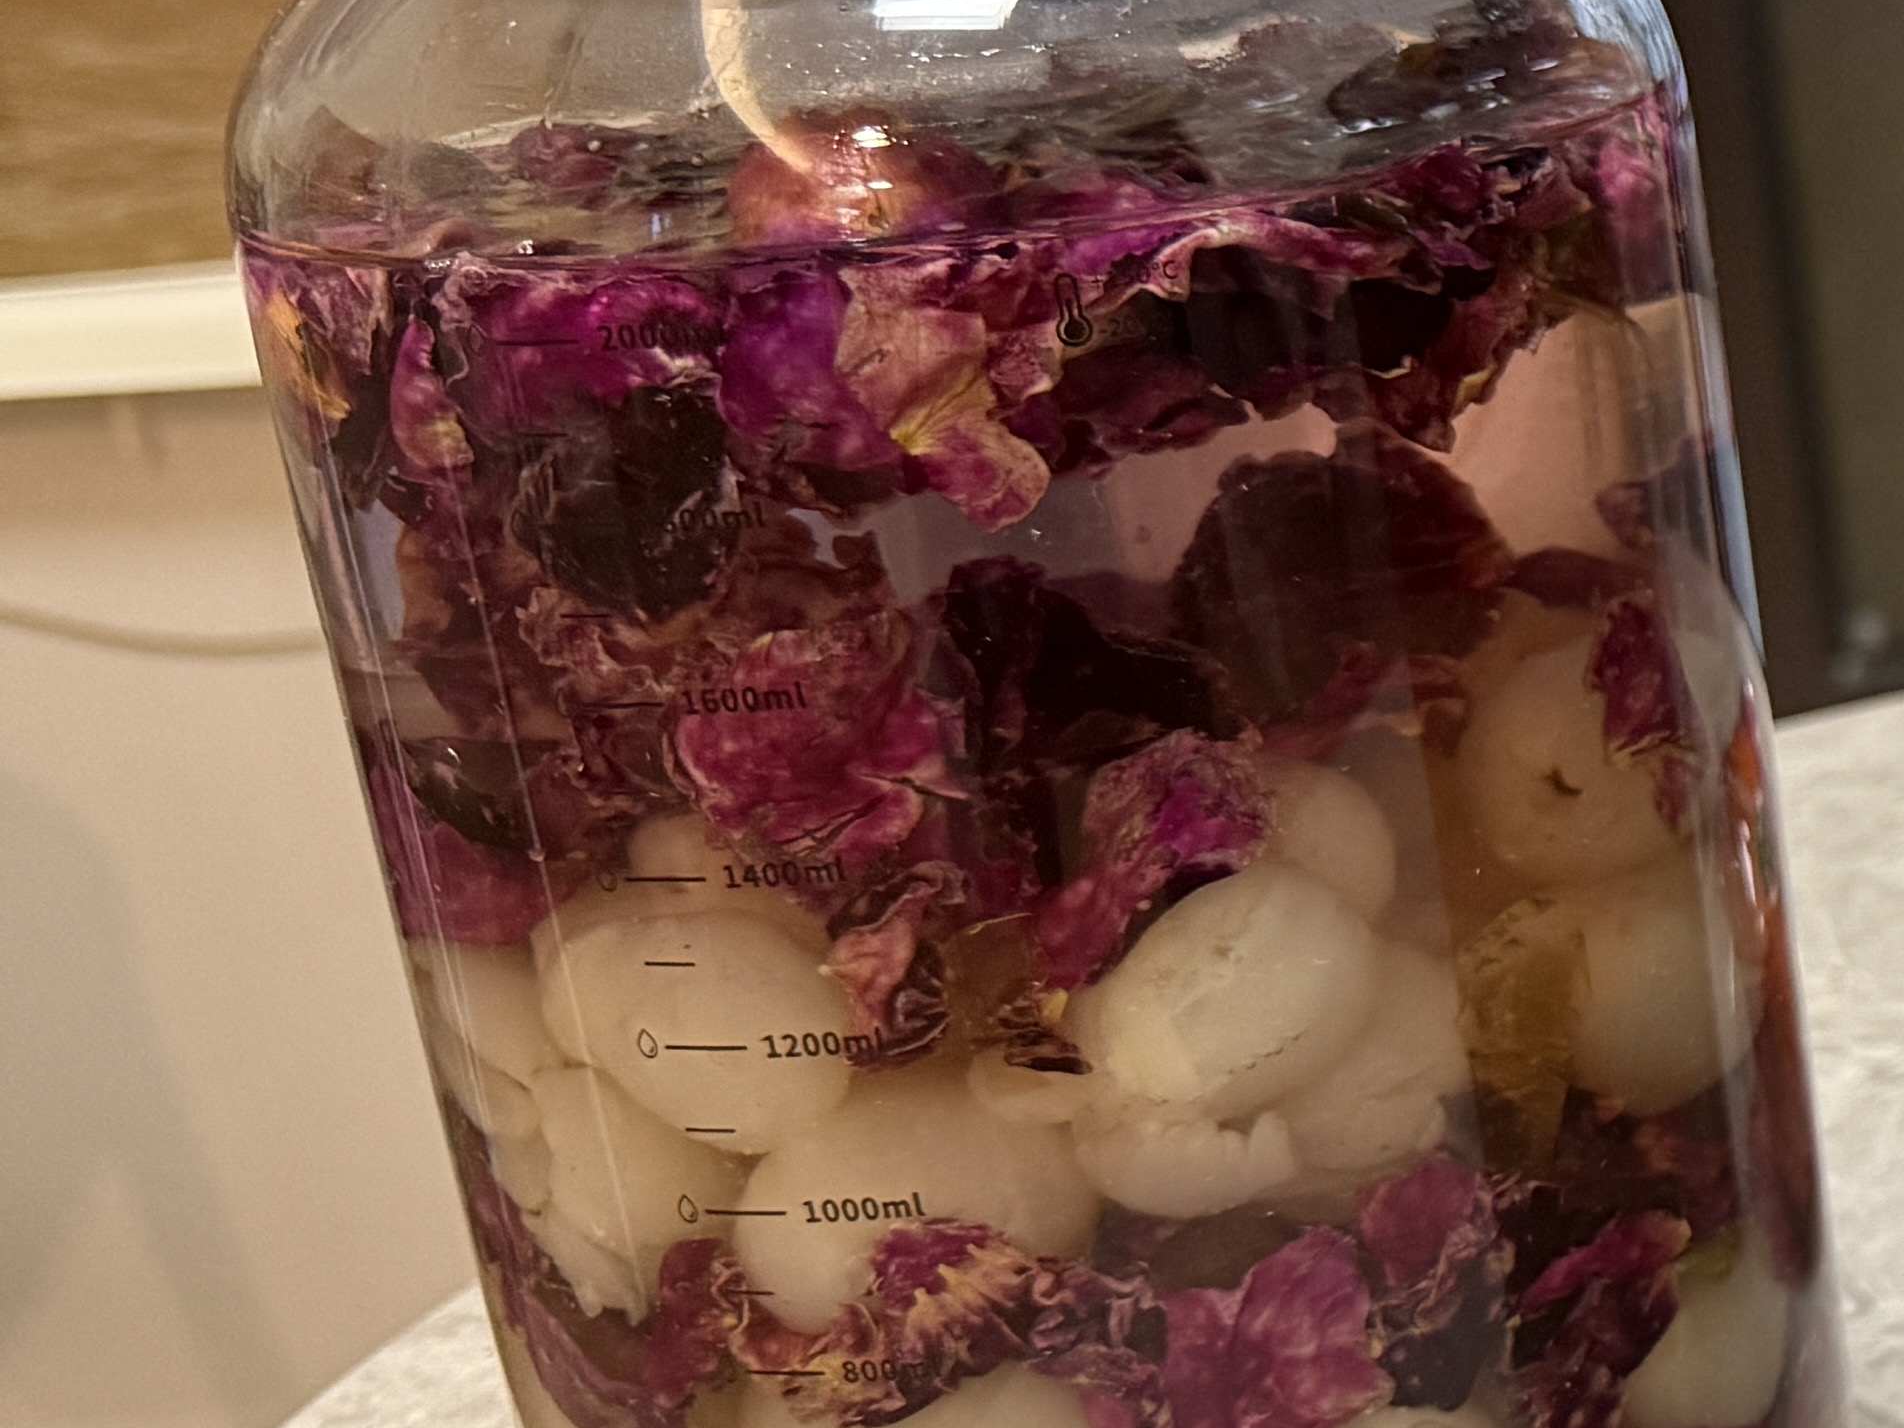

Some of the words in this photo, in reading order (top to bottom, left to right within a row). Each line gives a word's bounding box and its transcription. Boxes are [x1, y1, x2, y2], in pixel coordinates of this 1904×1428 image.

[682, 680, 809, 715] 1600ml
[723, 856, 847, 890] 1400ml
[763, 1026, 885, 1060] 1200ml
[802, 1193, 926, 1225] 1000ml
